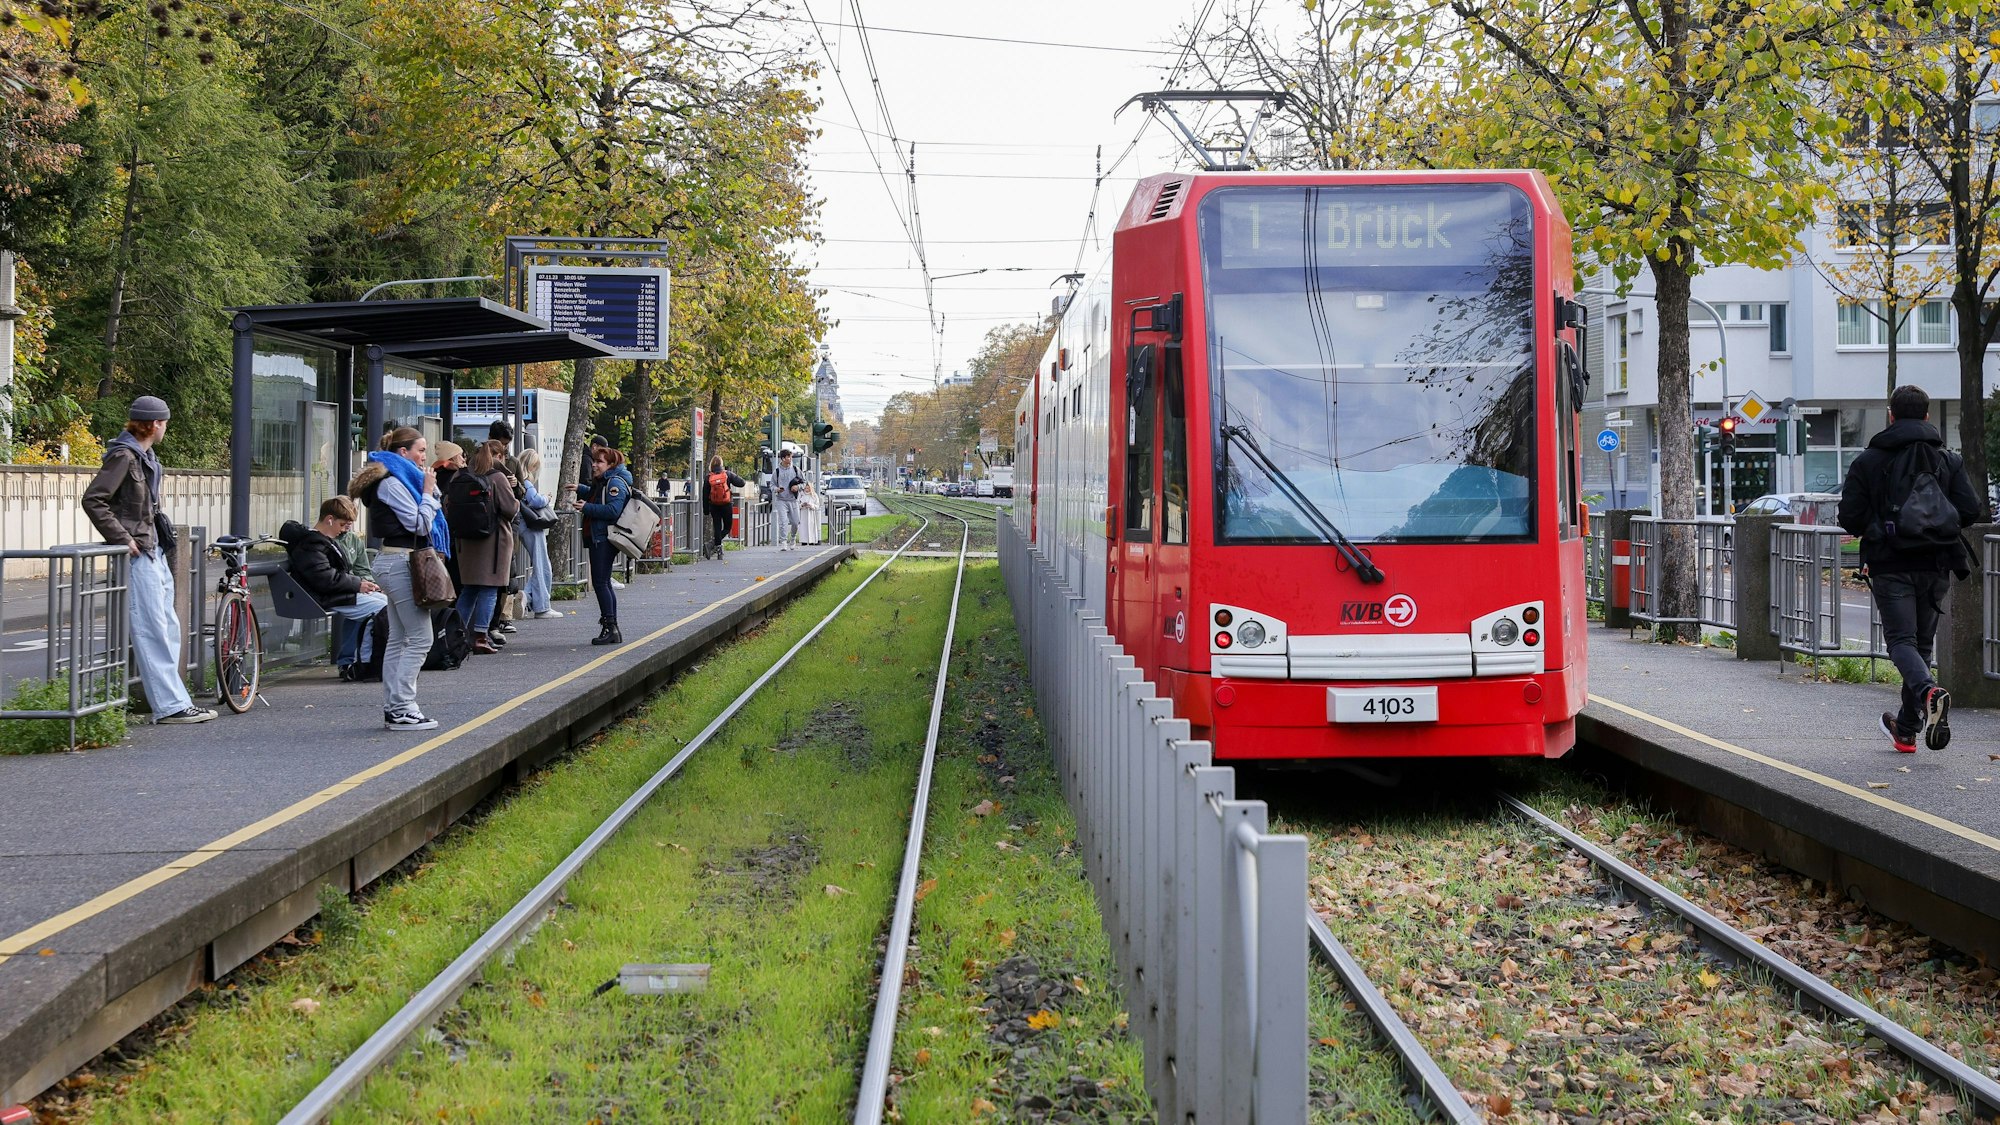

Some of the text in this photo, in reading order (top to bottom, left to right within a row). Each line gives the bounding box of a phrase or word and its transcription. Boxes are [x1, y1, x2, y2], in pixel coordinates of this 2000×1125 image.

[1250, 201, 1451, 249] 1 Brück
[1342, 603, 1383, 621] KVB
[1363, 698, 1414, 714] 4103
